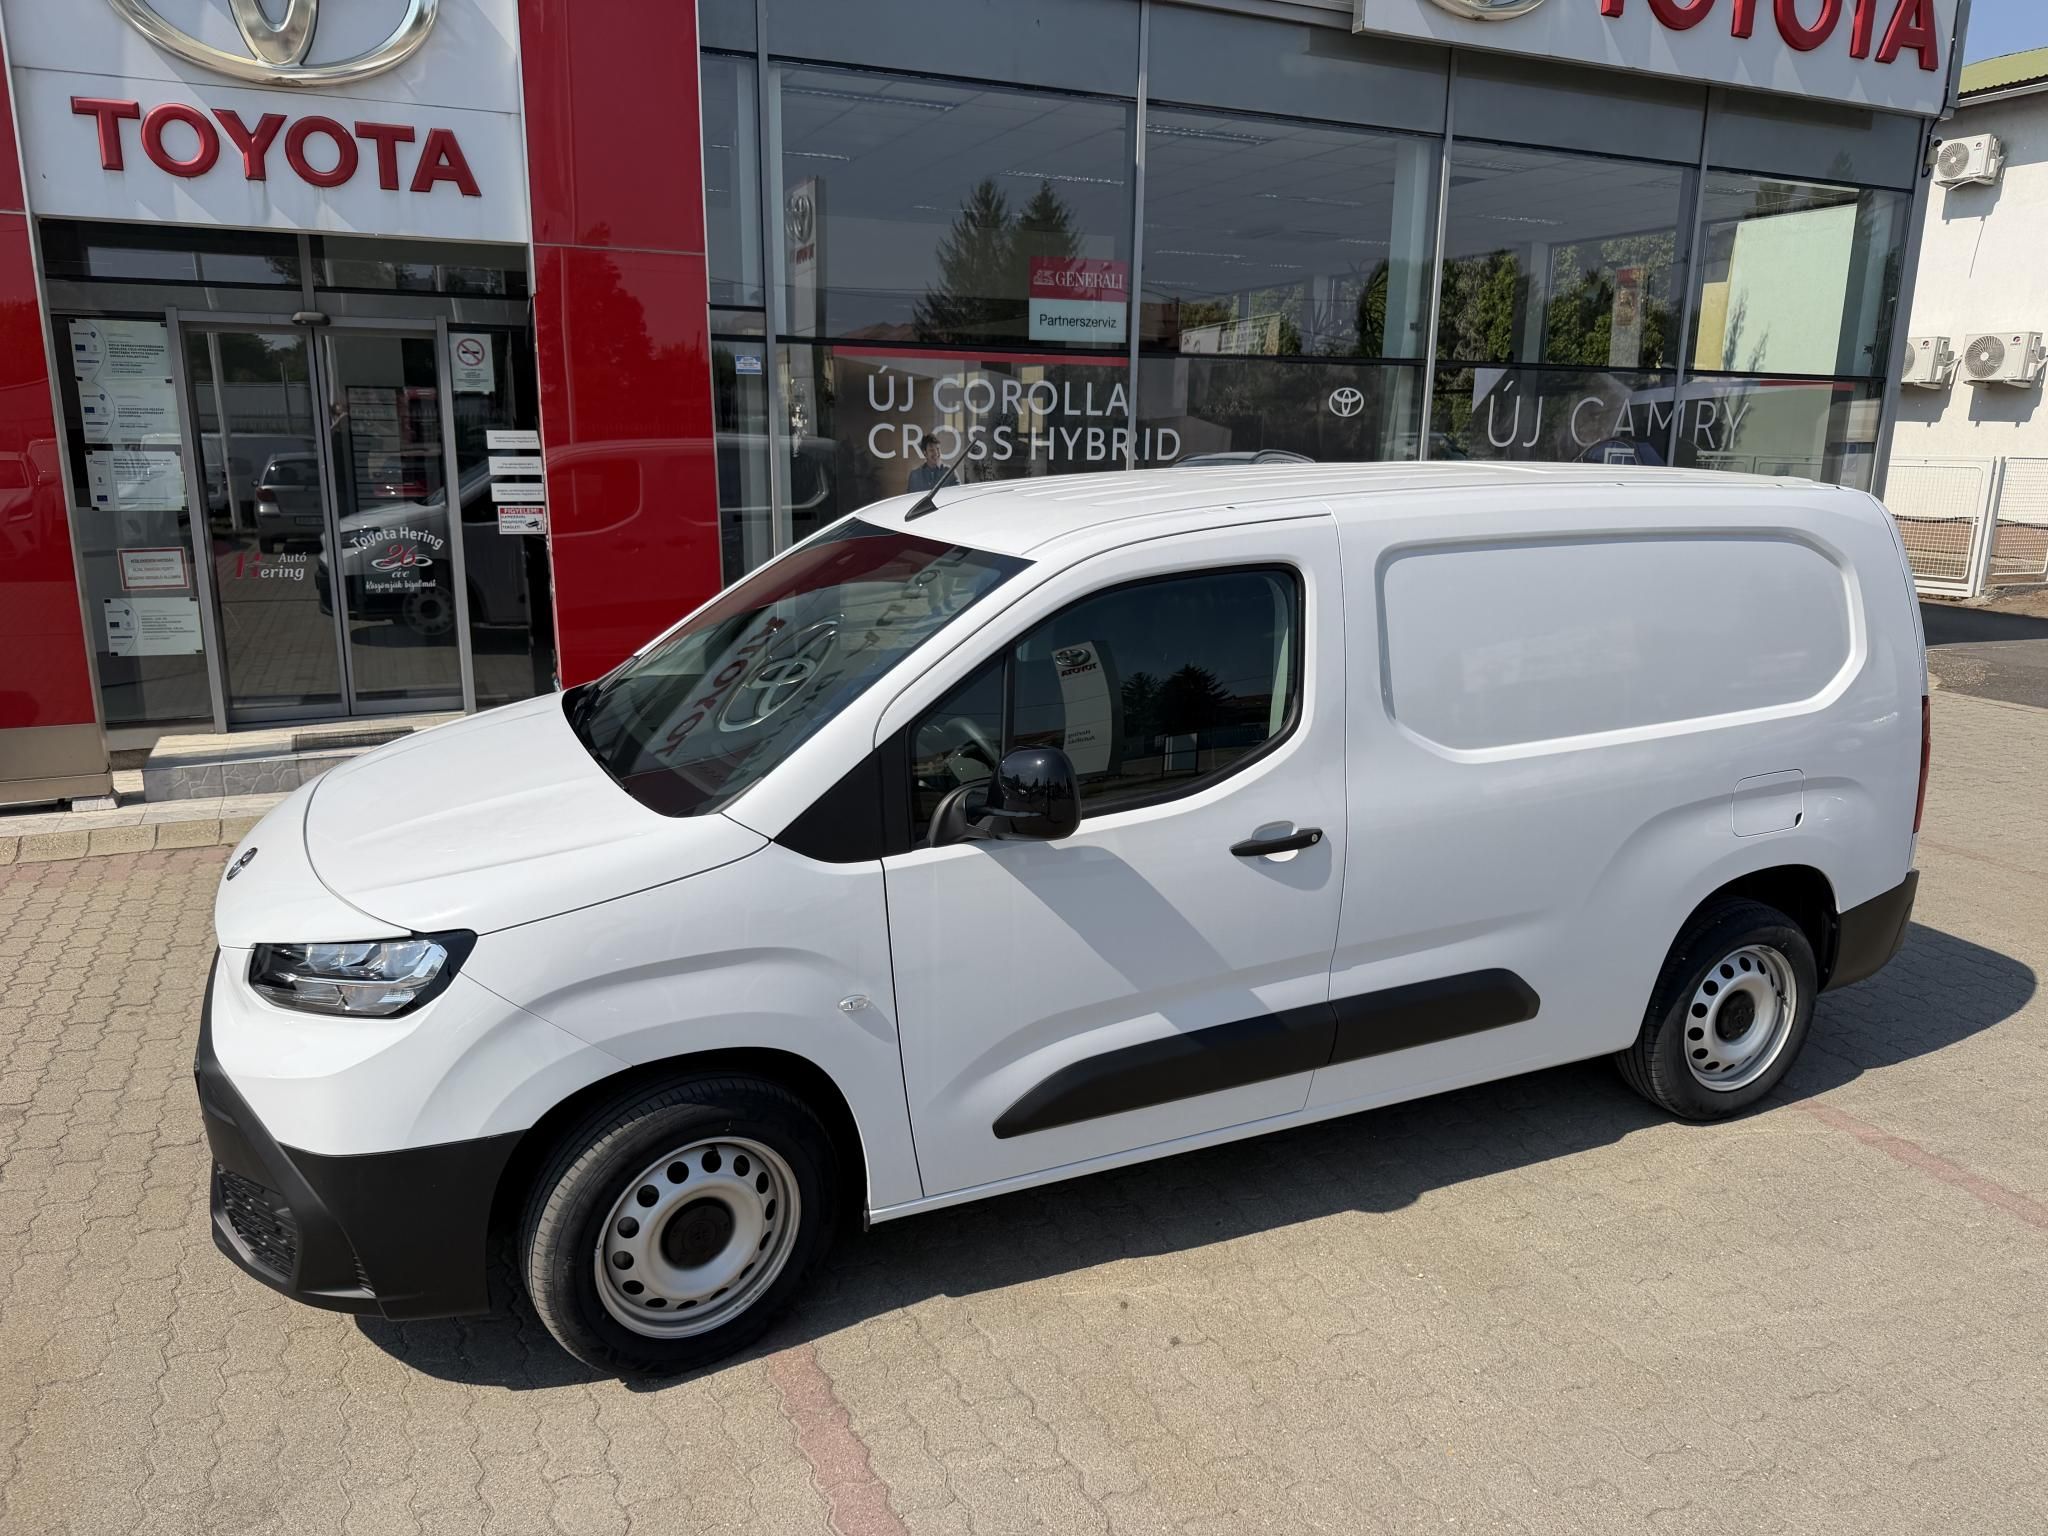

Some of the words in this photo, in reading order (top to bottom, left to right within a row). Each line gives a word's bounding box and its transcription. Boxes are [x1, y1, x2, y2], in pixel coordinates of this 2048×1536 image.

[1601, 0, 1939, 71] OTA
[70, 95, 482, 197] TOYOTA
[1055, 271, 1123, 289] GENERALI
[1039, 313, 1117, 329] Partnerszerviz
[868, 364, 914, 413] ÚJ
[932, 377, 1137, 417] COROLLA
[1487, 380, 1544, 448] ÚJ
[1569, 396, 1751, 449] CAMRY
[868, 422, 1013, 461] CROSS
[1030, 425, 1181, 462] HYBRID
[278, 552, 307, 563] Autó
[350, 529, 397, 549] Toyota
[399, 526, 444, 550] Hering
